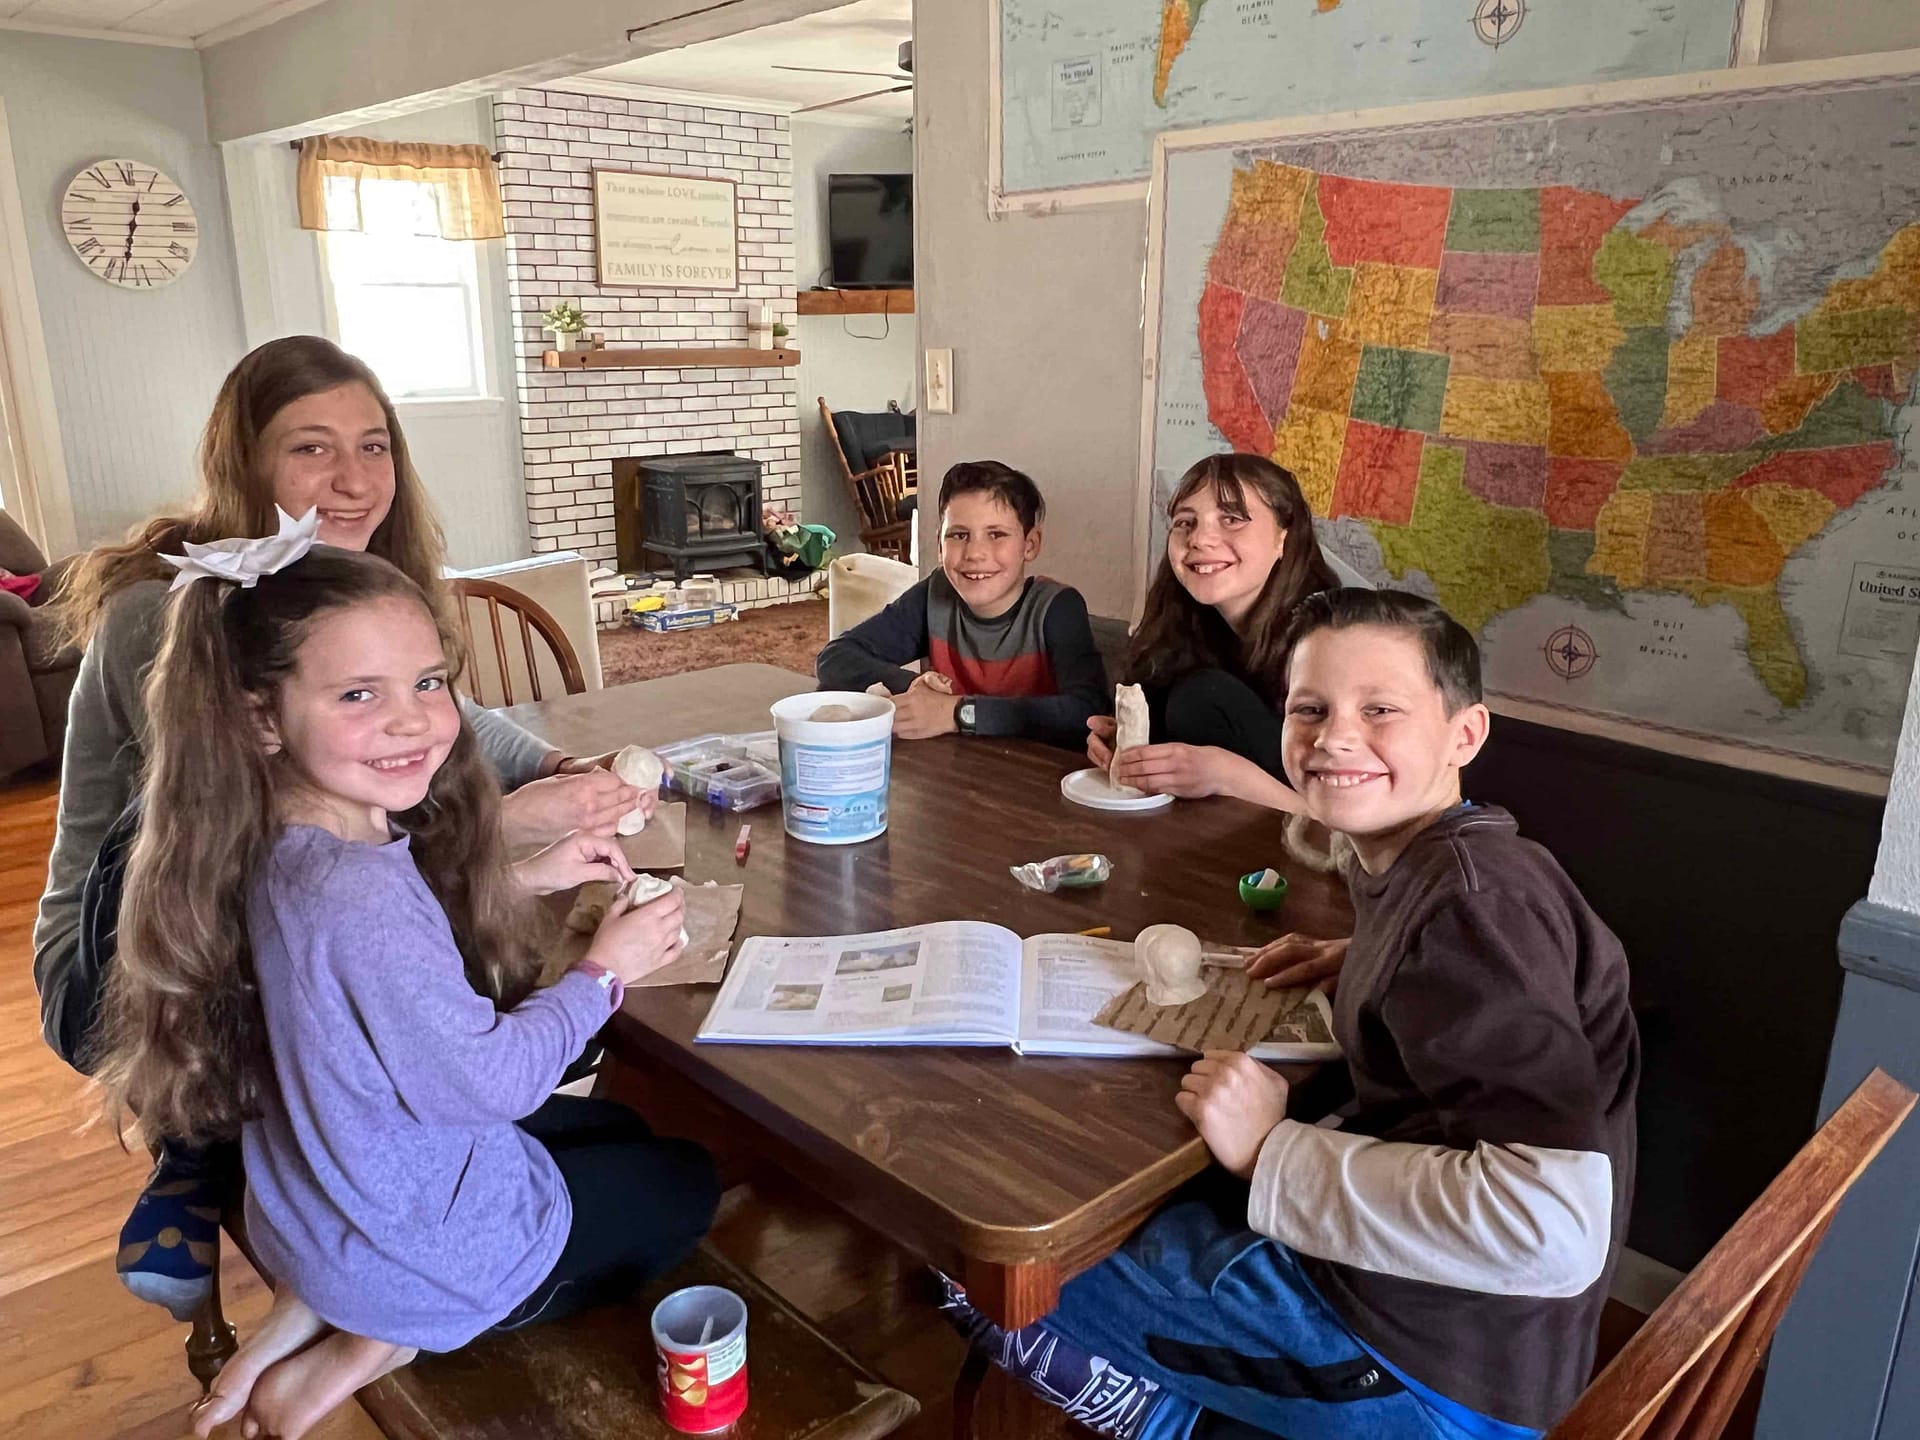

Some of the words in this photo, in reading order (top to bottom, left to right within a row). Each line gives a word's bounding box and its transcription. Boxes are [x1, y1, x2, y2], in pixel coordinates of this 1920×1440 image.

[667, 187, 697, 201] LOVE
[607, 262, 657, 277] FAMILY
[661, 265, 672, 277] IS
[675, 265, 733, 280] FOREVER
[1858, 580, 1906, 597] United
[1654, 619, 1683, 631] Gulf
[1640, 645, 1688, 660] Mexico
